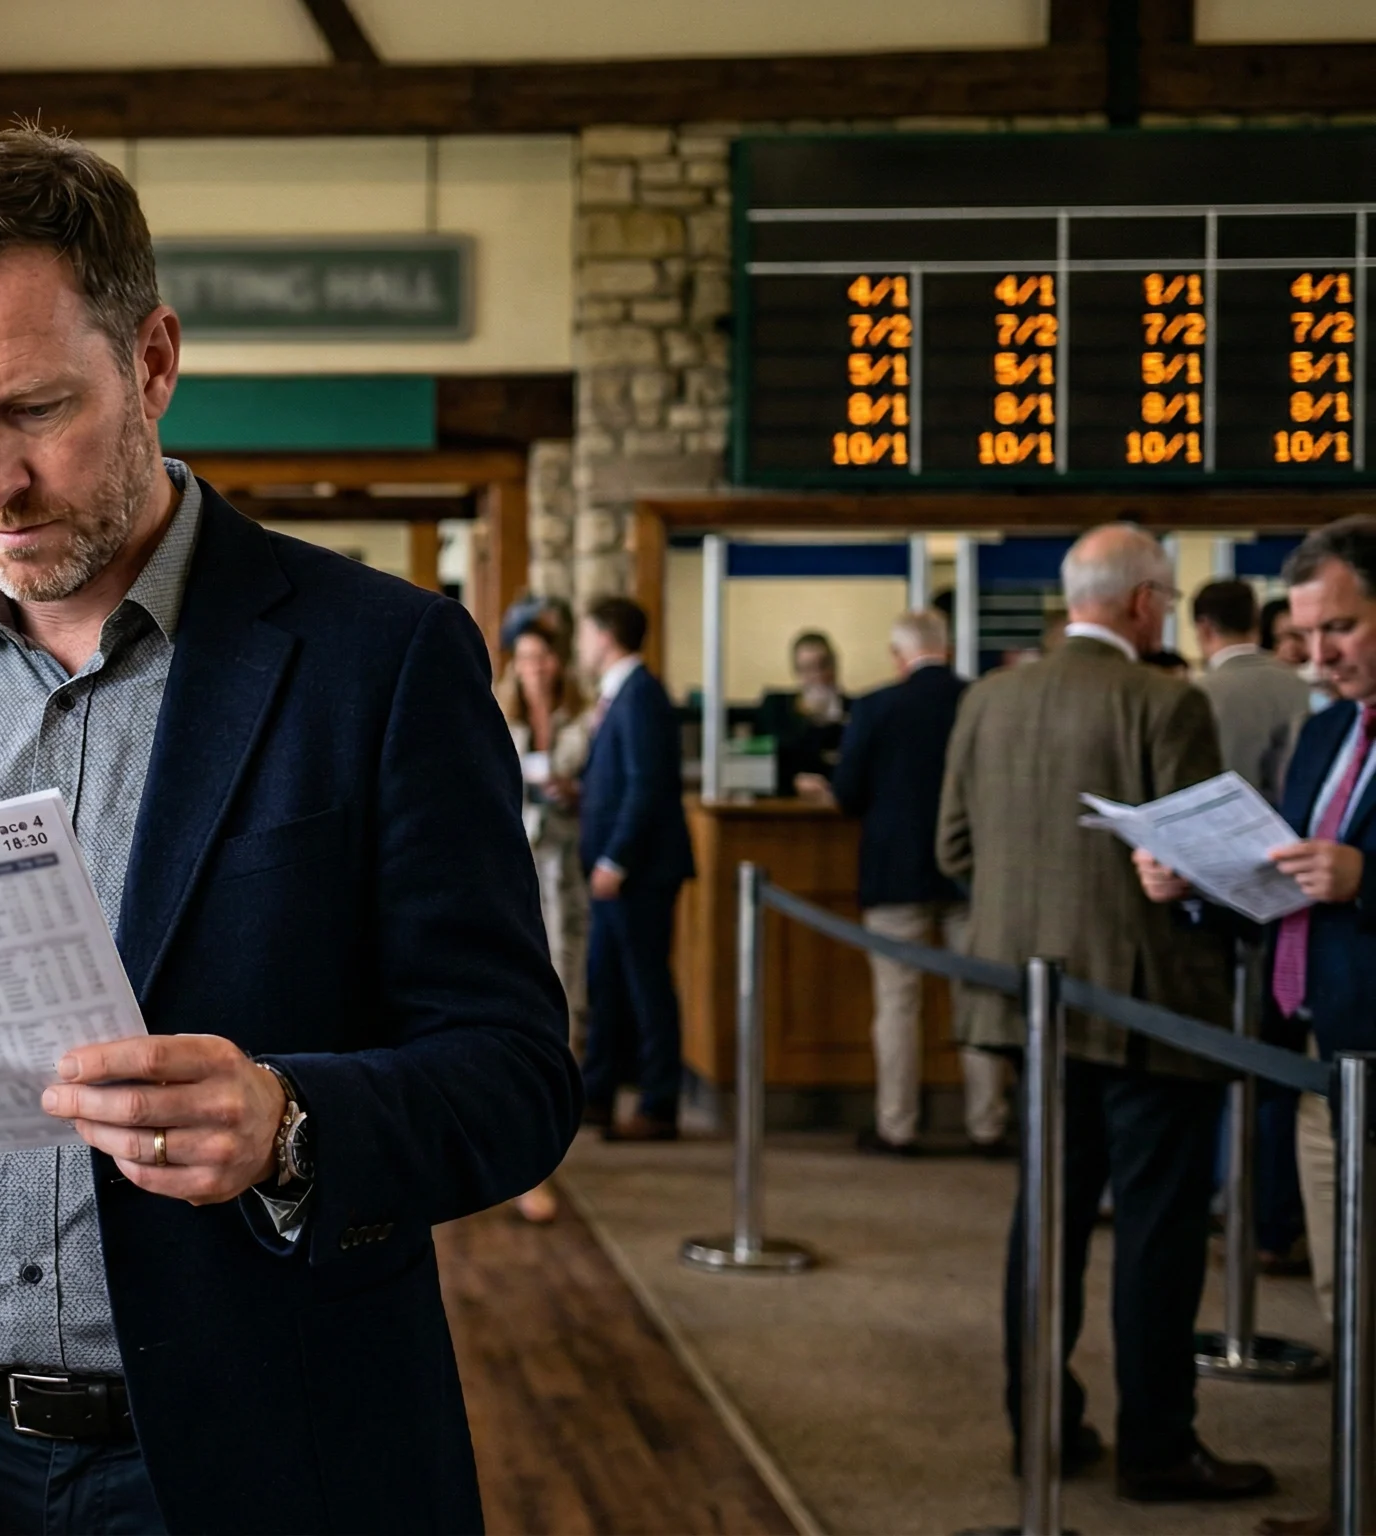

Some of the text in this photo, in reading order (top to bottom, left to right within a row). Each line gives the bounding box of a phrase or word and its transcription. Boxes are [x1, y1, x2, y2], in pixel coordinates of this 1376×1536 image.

[848, 275, 909, 308] 4/1
[995, 275, 1055, 307] 4/1
[1291, 273, 1352, 304] 4/1
[849, 311, 1355, 348] 7/2 7/2 7/2 7/2
[848, 351, 1351, 386] 5/1 5/1 5/1 5/1
[833, 430, 1350, 465] 10/1 10/1 10/1 10/1
[33, 815, 44, 827] 4
